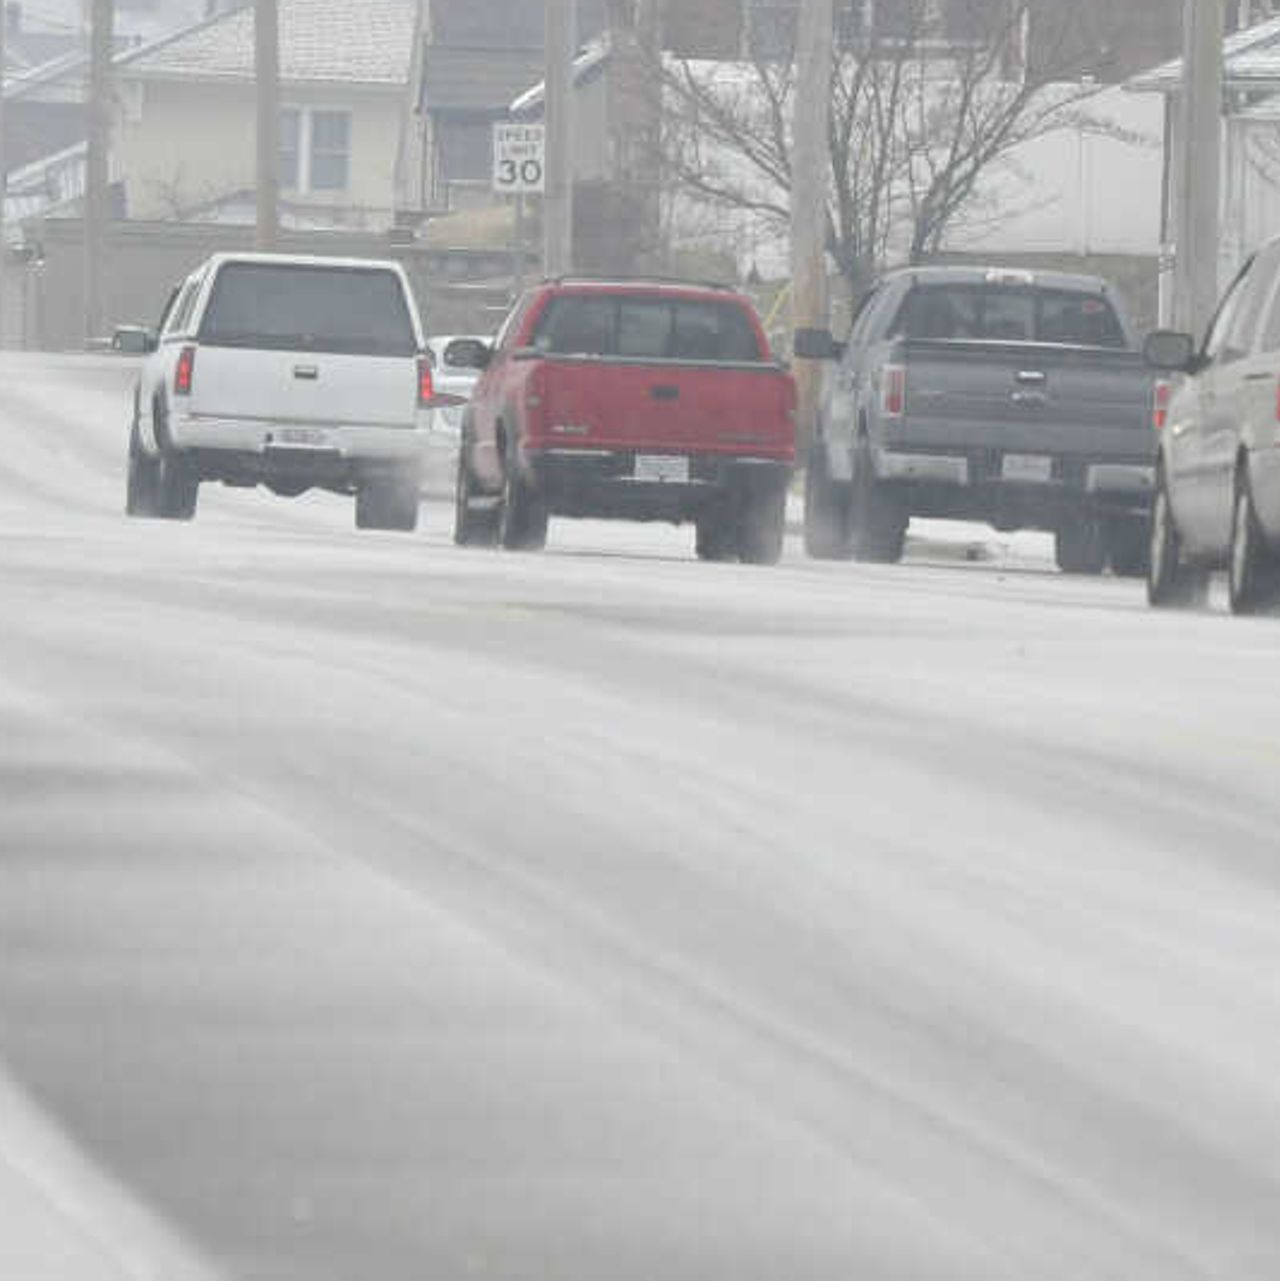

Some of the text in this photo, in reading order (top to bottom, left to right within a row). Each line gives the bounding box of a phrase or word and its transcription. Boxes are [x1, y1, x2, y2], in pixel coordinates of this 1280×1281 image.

[499, 128, 542, 142] SPEED
[500, 143, 538, 158] LIMIT
[497, 159, 542, 184] 30
